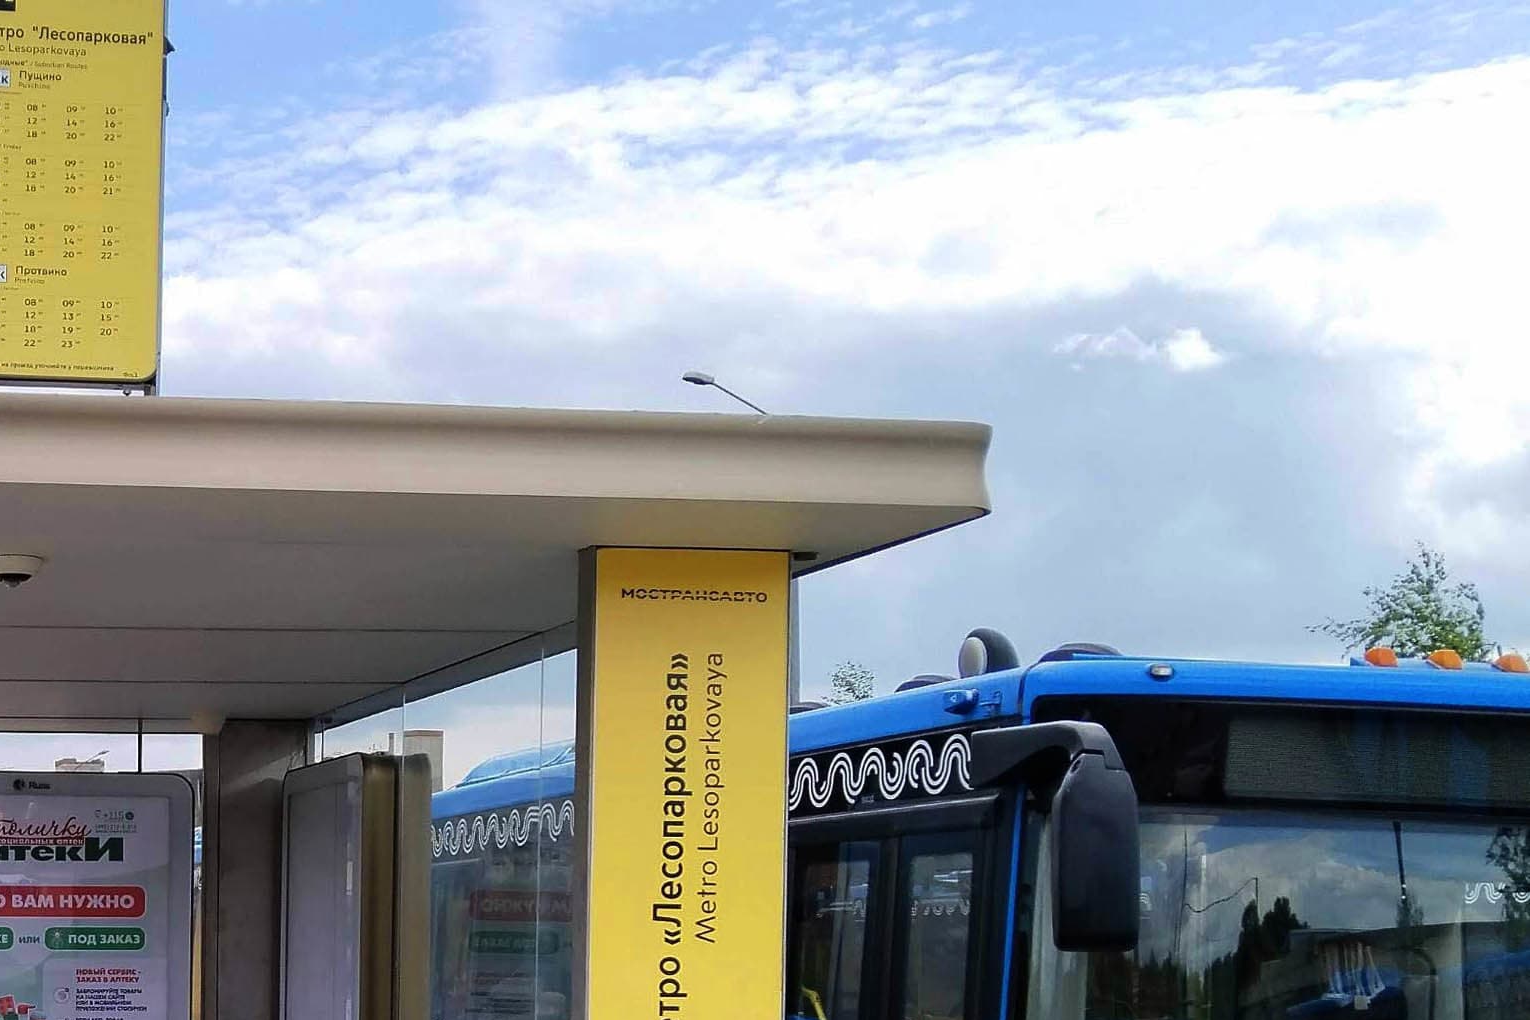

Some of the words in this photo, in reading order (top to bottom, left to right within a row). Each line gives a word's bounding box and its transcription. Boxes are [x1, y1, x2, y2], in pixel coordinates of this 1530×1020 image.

[32, 26, 153, 45] "Лесопарковая"
[9, 44, 86, 57] Lesoparkovaya
[19, 71, 61, 81] Пущино
[27, 117, 38, 125] 12
[101, 252, 111, 260] 22
[16, 266, 67, 276] Протвино
[101, 301, 112, 309] 10
[24, 339, 35, 347] 22
[62, 340, 73, 348] 23
[621, 588, 768, 603] МОСТРАНСАВТО
[696, 652, 728, 852] Lesoparkovaya
[652, 652, 693, 946] «Лесопарковая»
[11, 894, 55, 908] ВАМ
[59, 894, 135, 909] НУЖНО
[695, 859, 719, 944] Metro
[68, 934, 96, 945] ПОД
[100, 934, 140, 944] ЗАКАЗ
